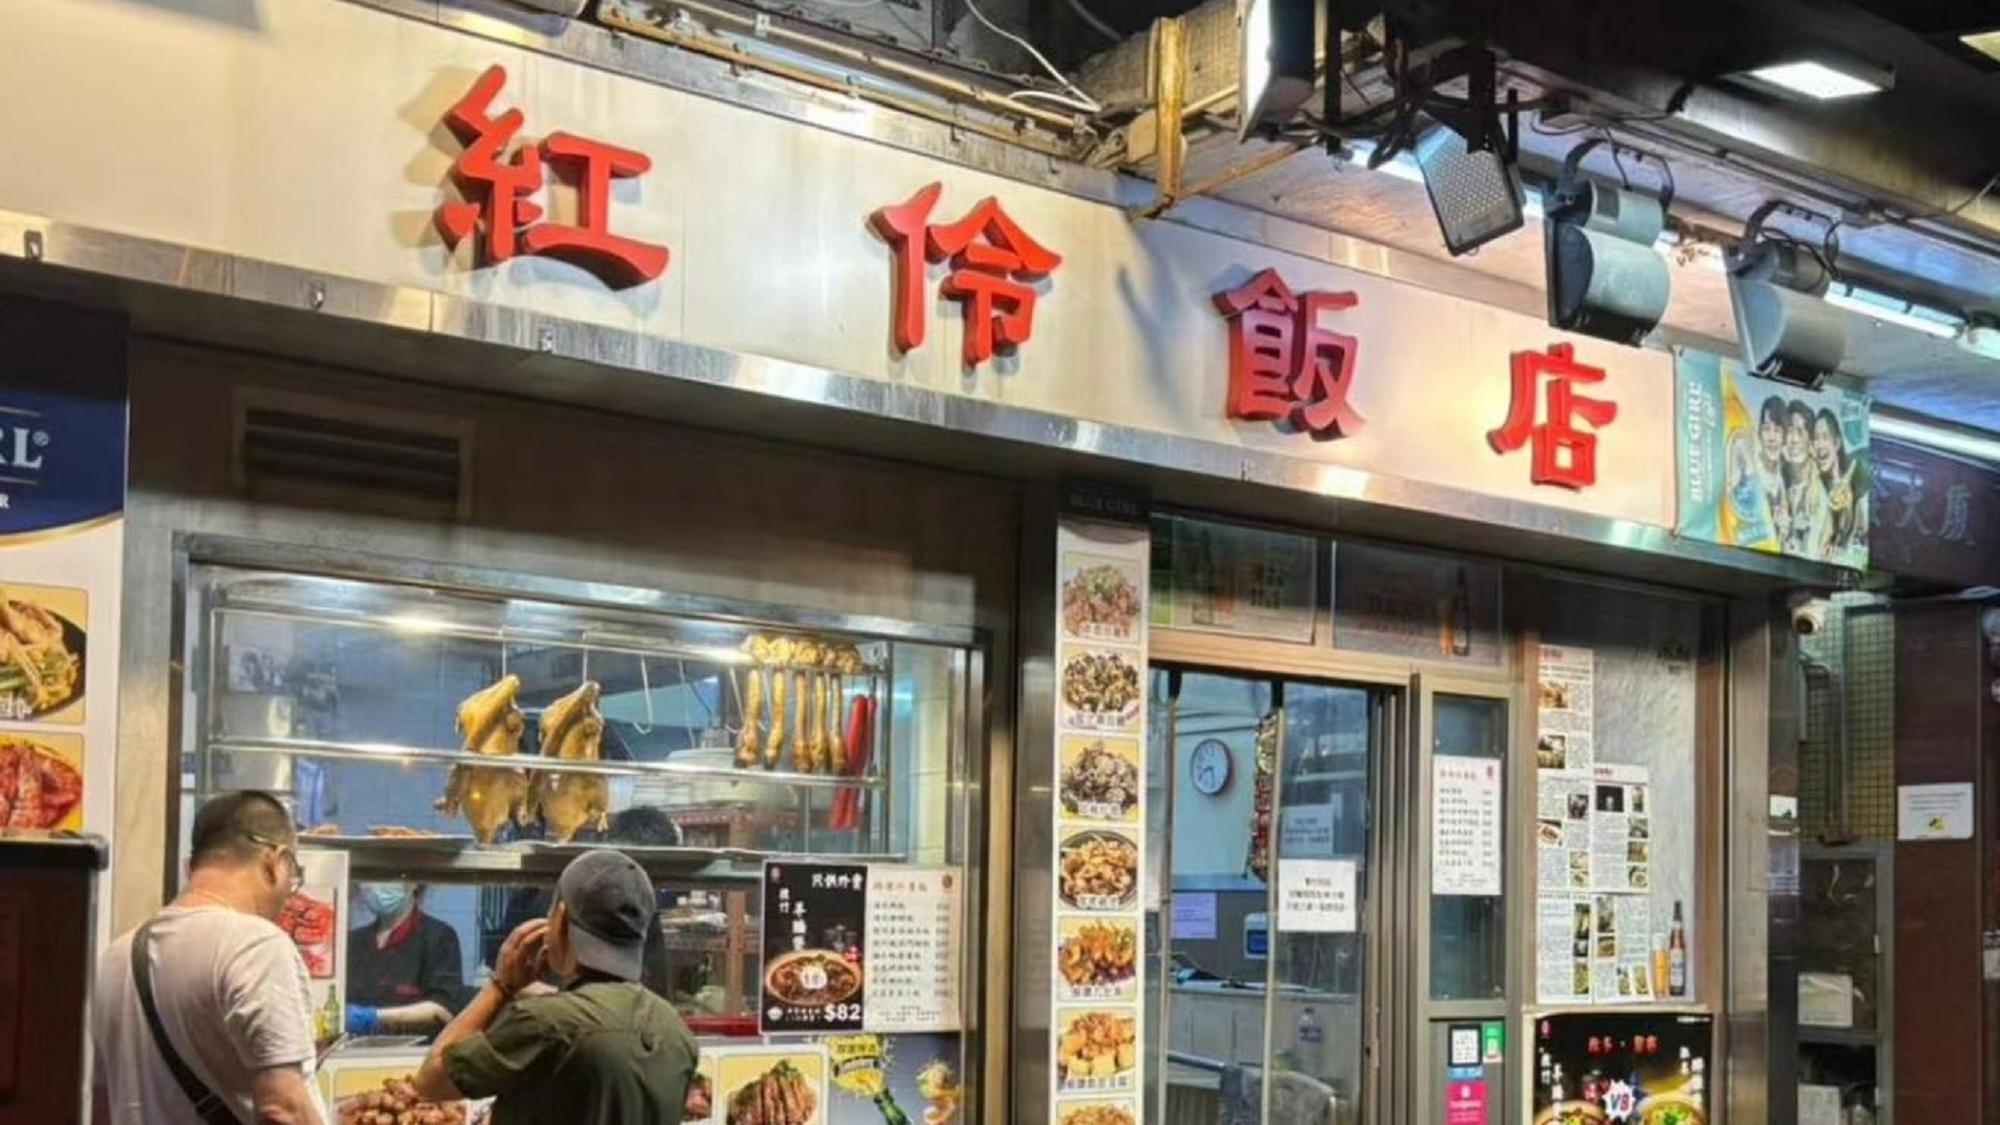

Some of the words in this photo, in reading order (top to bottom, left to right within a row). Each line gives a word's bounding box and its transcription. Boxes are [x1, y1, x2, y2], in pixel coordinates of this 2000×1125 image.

[436, 64, 1619, 491] 紅伶飯店
[823, 1003, 861, 1022] $82
[1609, 1094, 1631, 1111] VS
